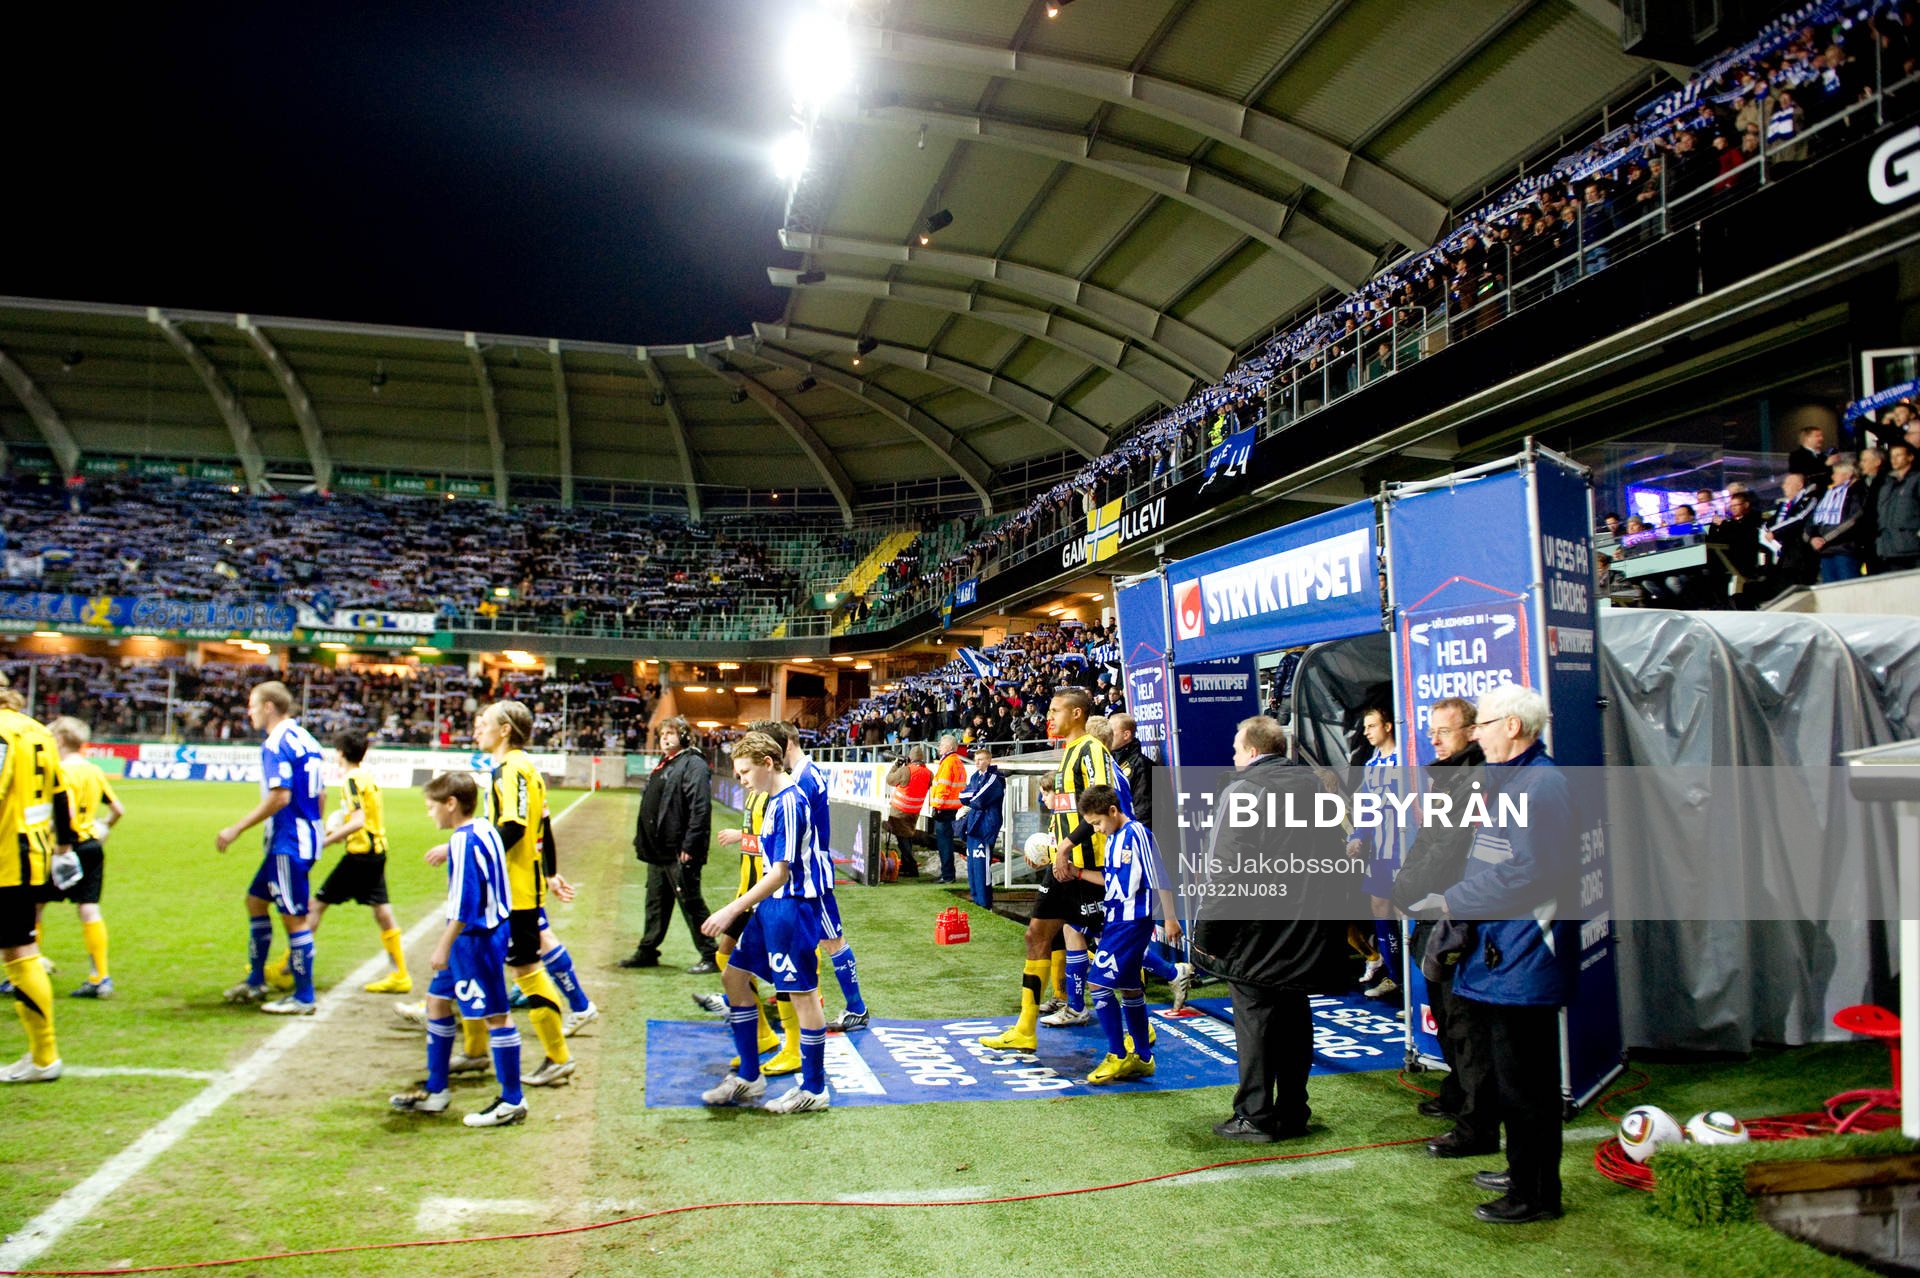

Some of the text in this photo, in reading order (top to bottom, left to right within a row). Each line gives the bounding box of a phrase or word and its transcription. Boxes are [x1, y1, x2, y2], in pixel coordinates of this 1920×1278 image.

[1062, 540, 1088, 569] GAM
[1543, 534, 1589, 576] VI SES PÅ
[1206, 541, 1364, 625] STRYKTIPSET
[1550, 572, 1588, 614] LÖRDAG
[1437, 638, 1488, 667] HELA
[1137, 681, 1155, 701] HELA
[1193, 676, 1248, 691] STRYKTIPSET
[1133, 702, 1164, 721] SVERIGES
[130, 761, 191, 780] NVS
[205, 763, 262, 782] NVS
[454, 979, 487, 1002] CA
[1074, 973, 1083, 995] SKF
[870, 1026, 978, 1086] LÖRDAG
